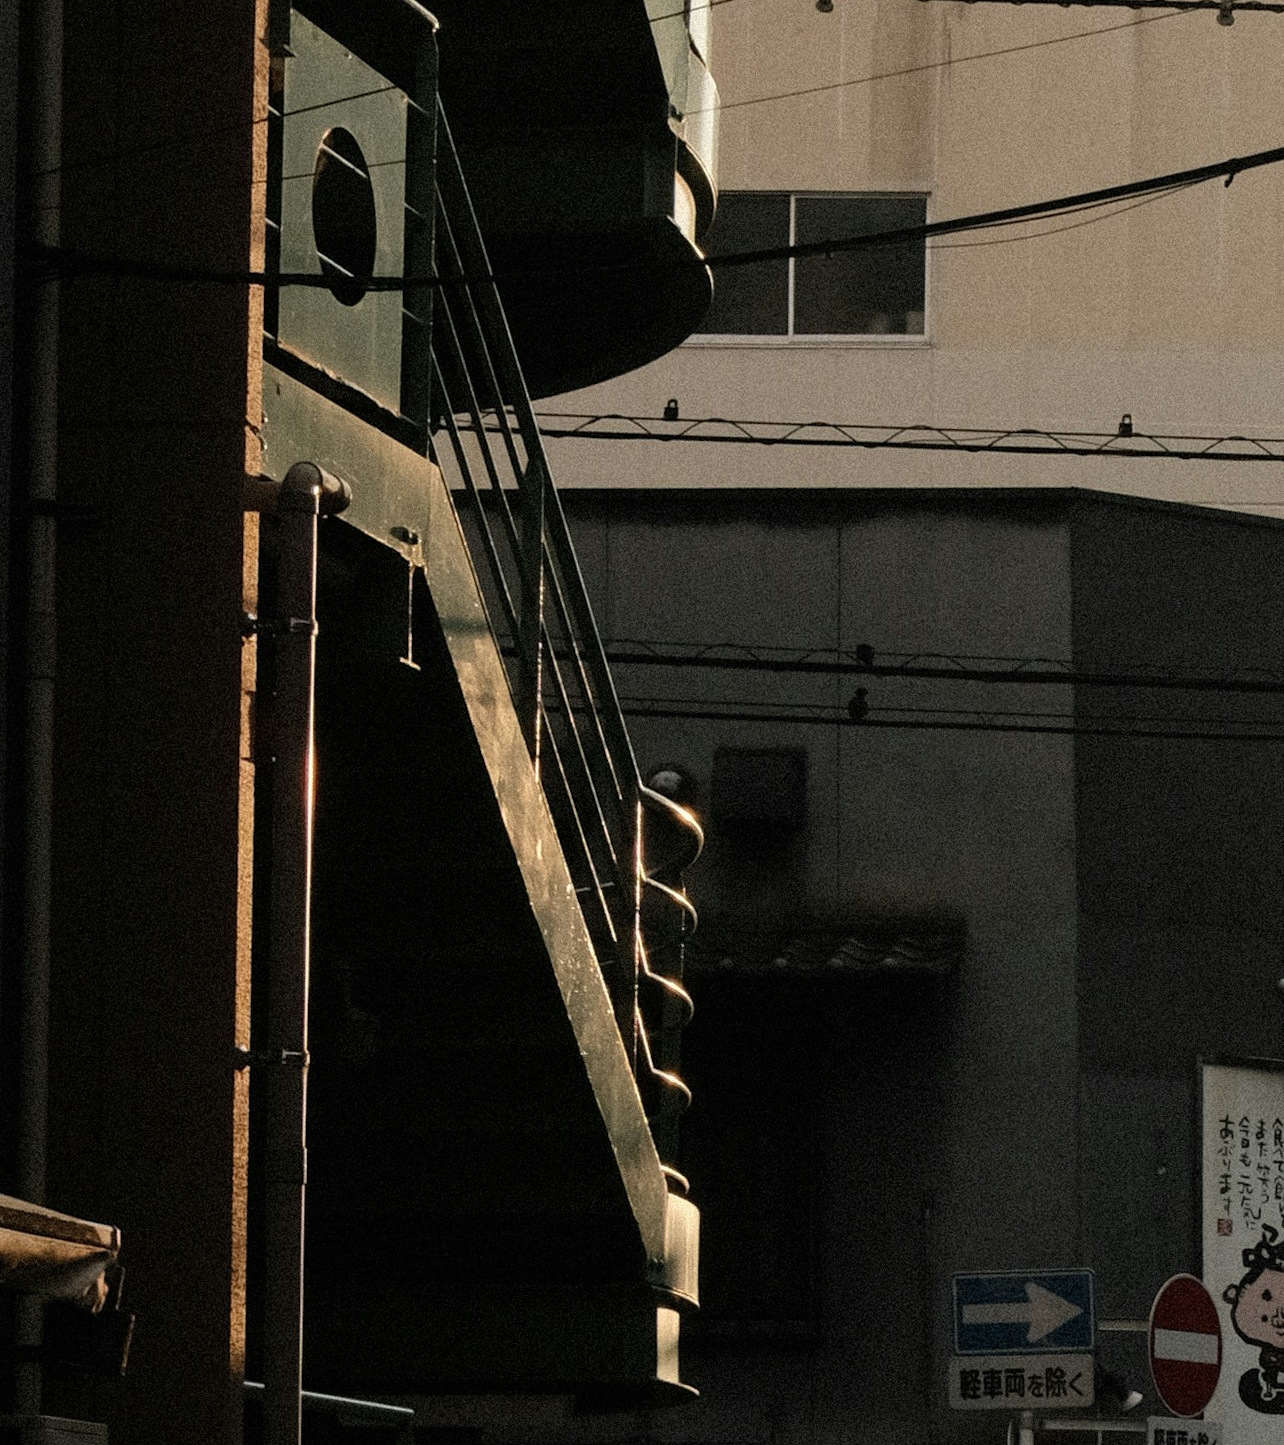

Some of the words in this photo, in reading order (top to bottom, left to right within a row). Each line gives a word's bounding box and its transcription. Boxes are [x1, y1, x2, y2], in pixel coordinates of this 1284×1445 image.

[958, 1362, 1085, 1402] 軽車両を除く
